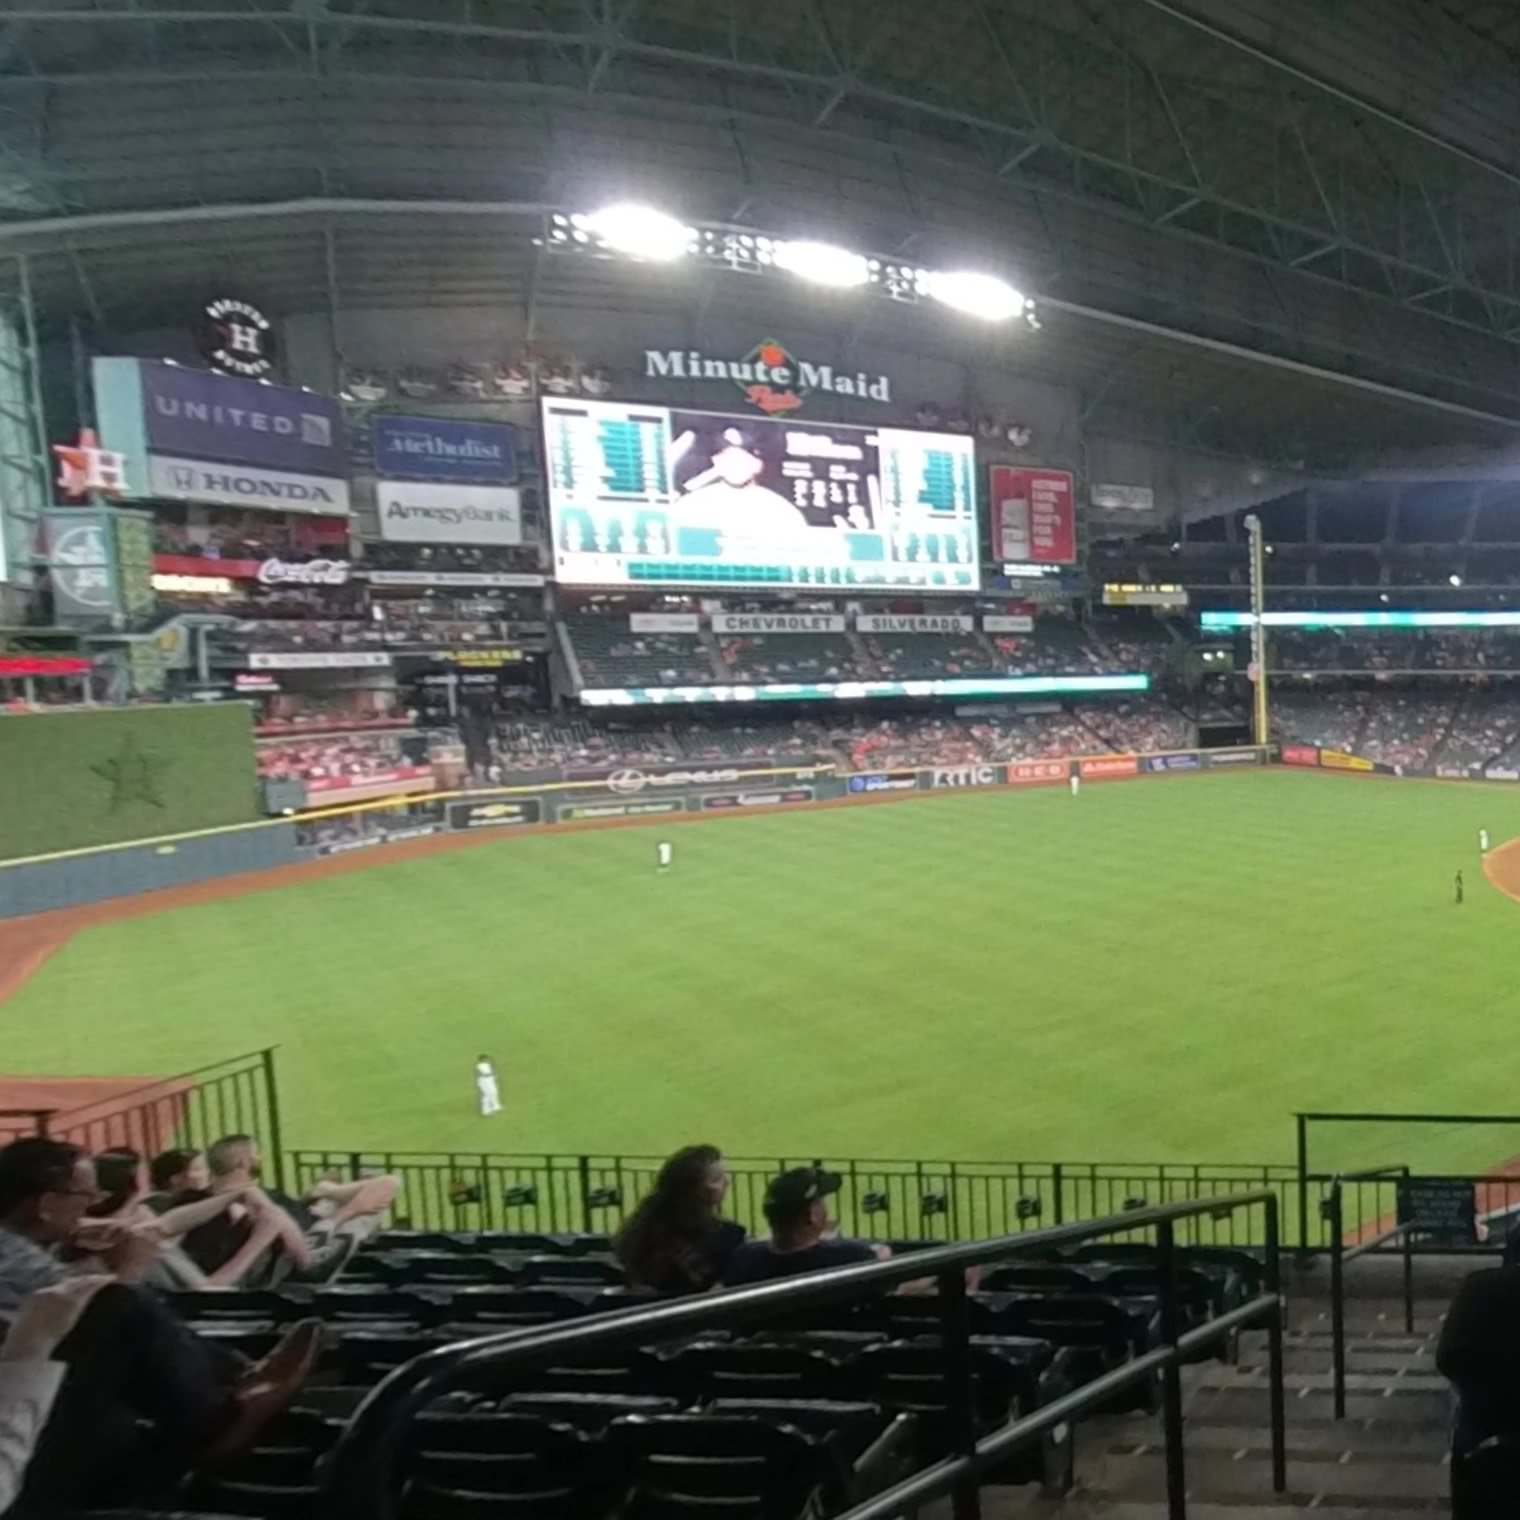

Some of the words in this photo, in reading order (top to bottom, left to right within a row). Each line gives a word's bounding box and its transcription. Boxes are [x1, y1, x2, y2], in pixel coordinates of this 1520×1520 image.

[644, 350, 791, 384] Minute
[797, 361, 891, 402] Maid
[155, 395, 295, 435] UNITED
[385, 436, 502, 459] Methodist
[203, 473, 338, 503] HONDA
[725, 617, 833, 631] CHEVROLET
[871, 617, 961, 632] SILVERADO
[933, 767, 994, 786] RTIC
